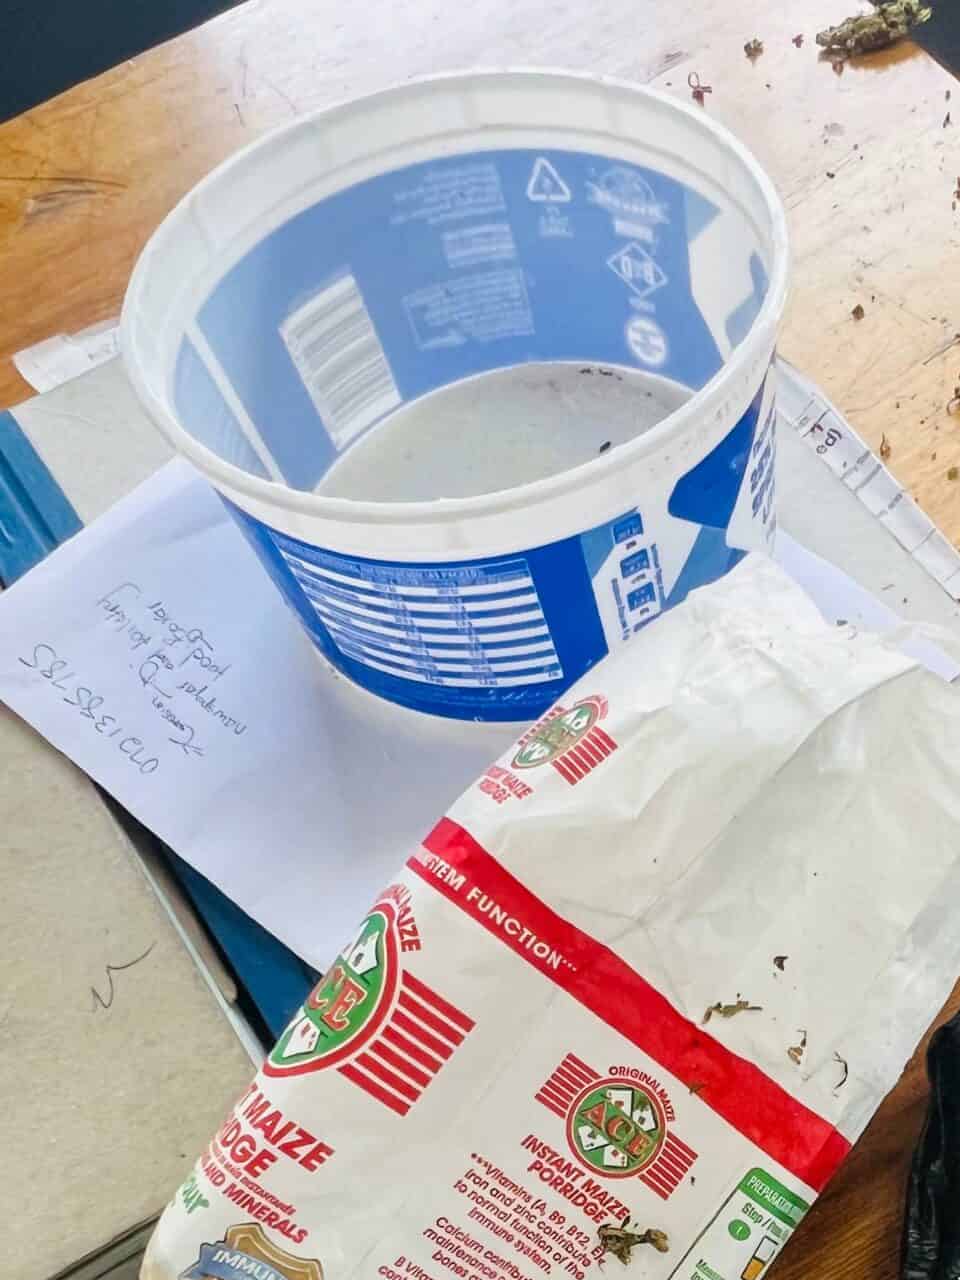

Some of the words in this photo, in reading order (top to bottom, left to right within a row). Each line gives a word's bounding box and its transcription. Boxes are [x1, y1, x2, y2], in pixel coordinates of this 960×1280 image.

[304, 966, 367, 1033] CE
[610, 1066, 656, 1095] ORIGINAL
[239, 1093, 335, 1174] MAIZE
[579, 1095, 654, 1160] ACE
[520, 1134, 583, 1185] INSTANT
[579, 1178, 629, 1221] MAIZE
[526, 1160, 607, 1224] PORRIDGE
[223, 1178, 308, 1247] MINERALS
[435, 1215, 484, 1255] Calcium
[454, 1178, 468, 1193] to
[467, 1187, 511, 1223] normal
[510, 1218, 552, 1252] function
[550, 1248, 567, 1264] of
[563, 1259, 587, 1280] the
[488, 1185, 513, 1207] and
[512, 1201, 537, 1224] zinc
[534, 1219, 594, 1267] contribute
[565, 1225, 595, 1251] B12,
[394, 1255, 406, 1268] B
[432, 1249, 468, 1279] bones
[512, 1240, 554, 1274] system.
